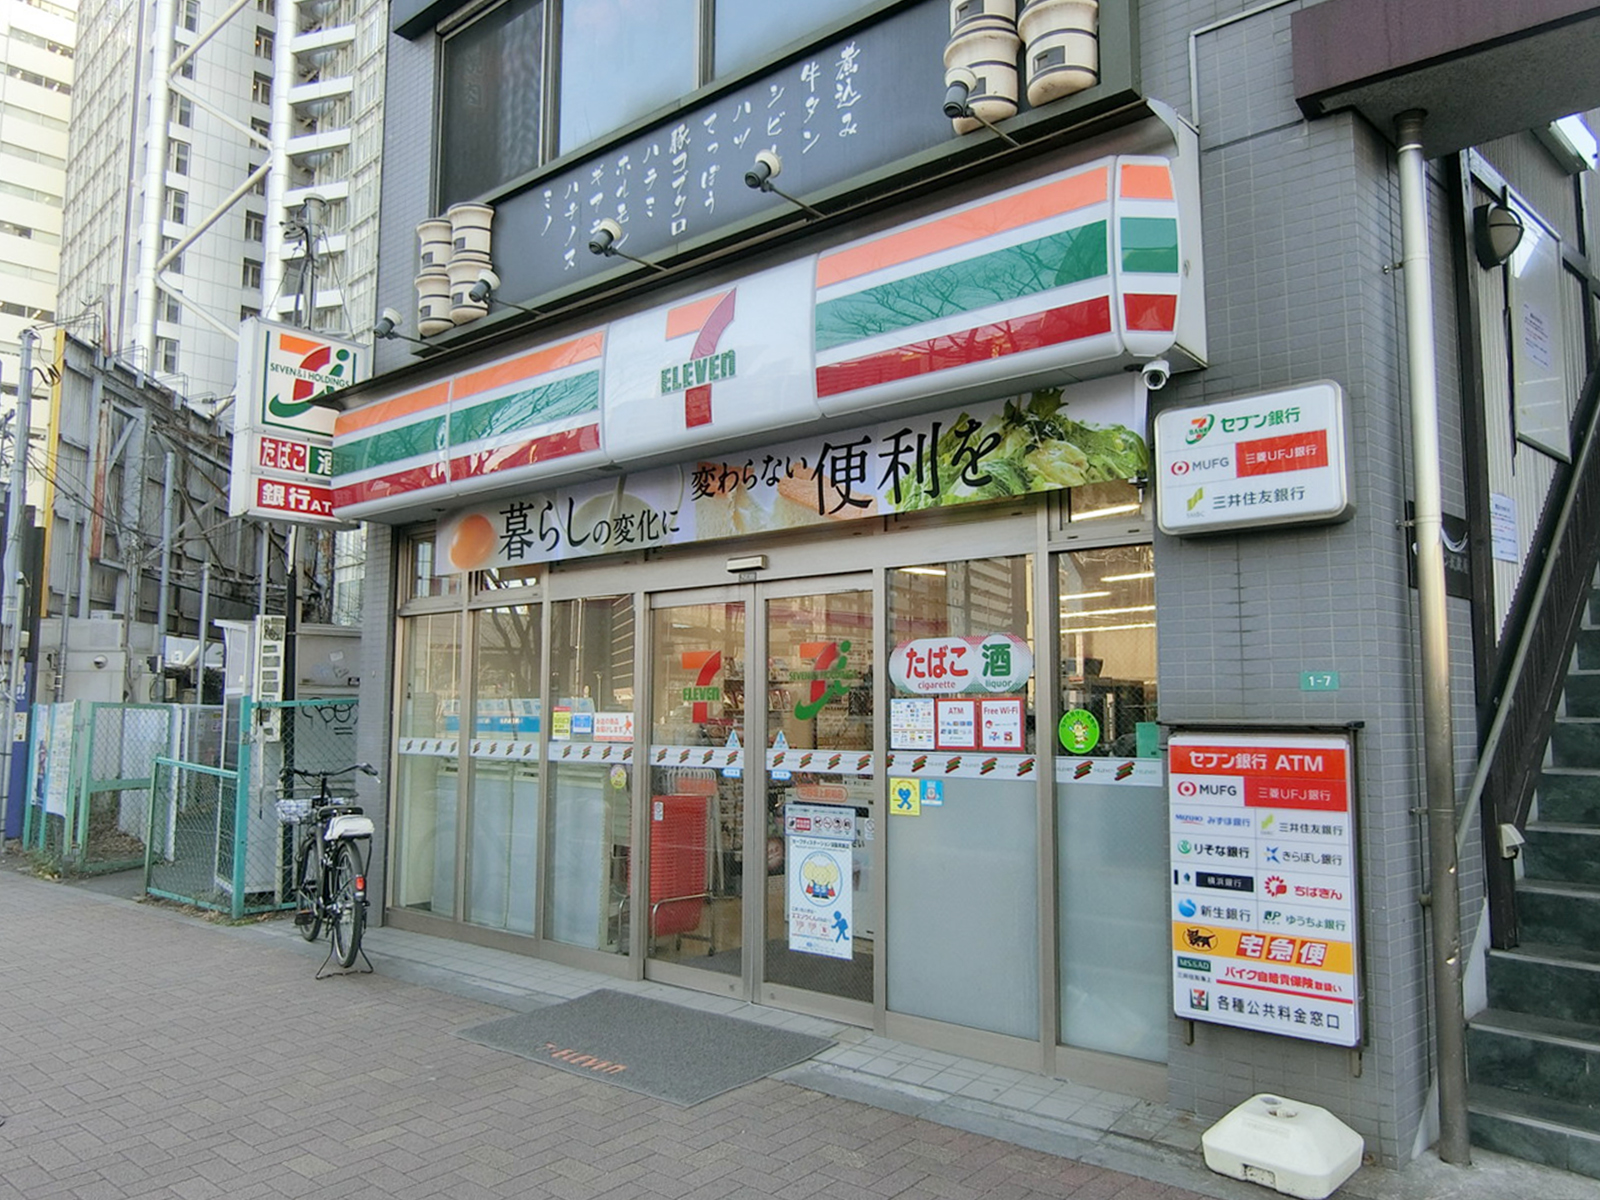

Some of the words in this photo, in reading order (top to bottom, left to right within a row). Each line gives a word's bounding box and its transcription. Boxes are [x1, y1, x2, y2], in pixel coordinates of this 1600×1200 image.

[801, 61, 821, 154] 牛タン
[732, 101, 751, 149] ハツ
[767, 84, 786, 153] シビ
[642, 143, 659, 218] ハラミ
[669, 123, 691, 236] 豚コブクロ
[541, 189, 553, 237] ミノ
[563, 181, 579, 271] ハチノス
[307, 371, 350, 389] HOLDINGS
[1220, 406, 1301, 434] セブン銀行
[261, 438, 306, 473] たばこ
[1191, 457, 1230, 472] MUFG
[1245, 444, 1317, 465] 三菱UFJ銀行
[1212, 485, 1306, 510] 三井住友銀行
[498, 496, 680, 561] 暮らしの変化に
[906, 645, 968, 679] たばこ
[982, 643, 1011, 677] 酒
[917, 680, 956, 690] cigarette
[985, 679, 1013, 688] liquor
[1308, 676, 1332, 687] 1-7
[948, 707, 964, 715] ATM
[984, 706, 999, 715] Free
[1000, 706, 1018, 715] Wi-Fi
[1189, 750, 1268, 771] セブン銀行
[1275, 754, 1324, 772] ATM
[1199, 784, 1237, 797] MUFG
[1258, 786, 1331, 802] 三菱UFJ銀行
[1207, 816, 1250, 827] みずほ銀行
[1279, 822, 1343, 836] 三井住友銀行
[1194, 843, 1250, 859] りそな銀行
[1282, 851, 1343, 866] きらぼし銀行
[1200, 905, 1251, 923] 新生銀行
[1286, 915, 1347, 932] ゆうちょ銀行
[1239, 935, 1327, 967] 宅急便
[1217, 994, 1340, 1030] 各種公共料金窓口
